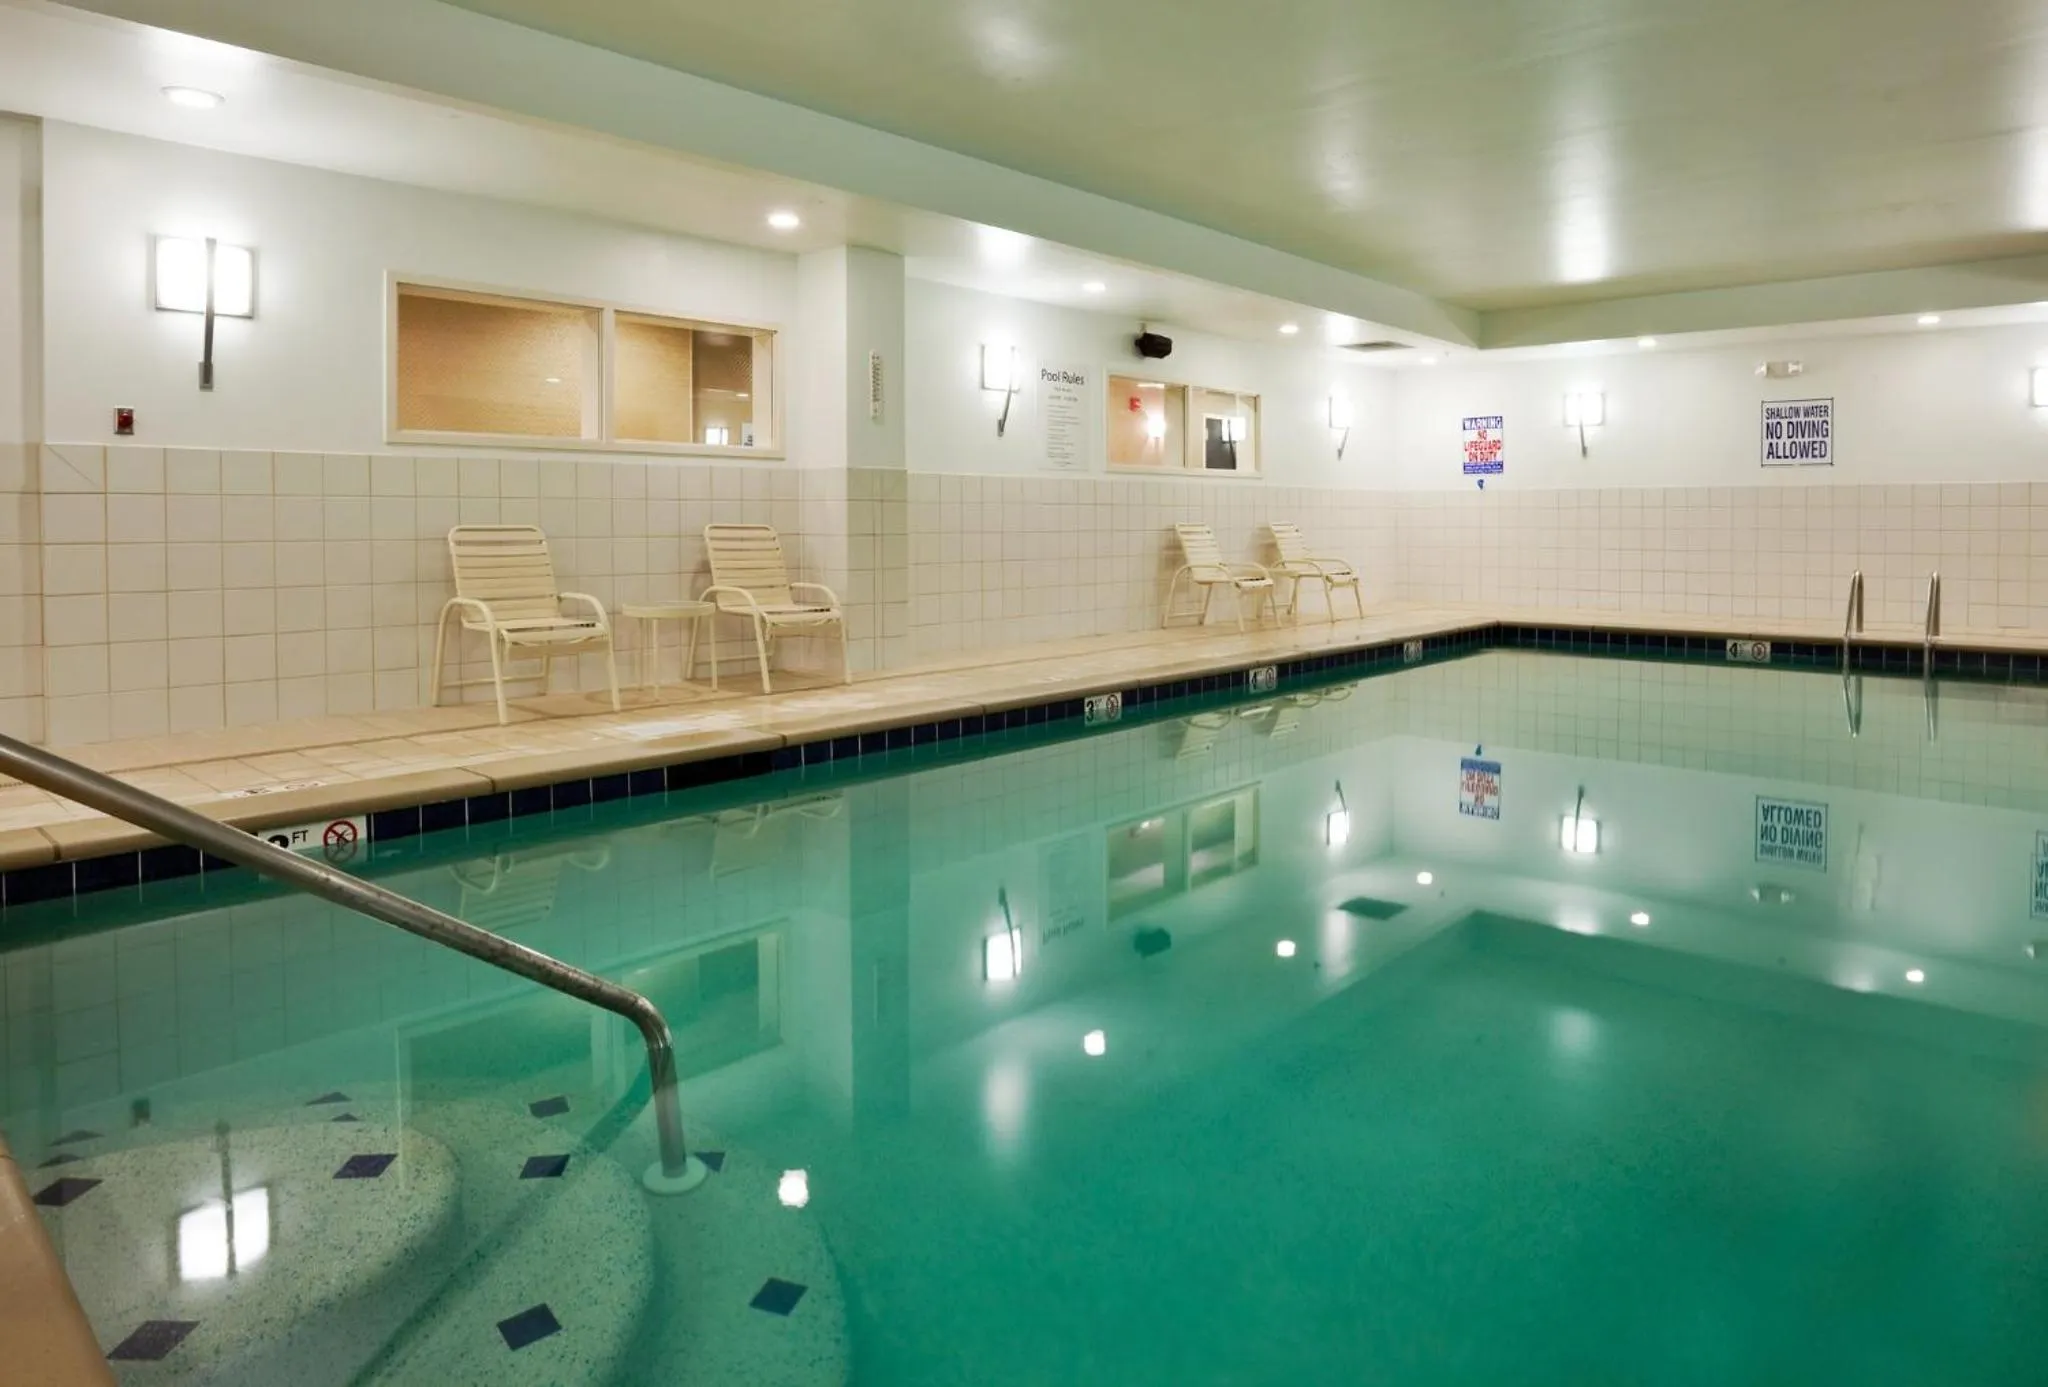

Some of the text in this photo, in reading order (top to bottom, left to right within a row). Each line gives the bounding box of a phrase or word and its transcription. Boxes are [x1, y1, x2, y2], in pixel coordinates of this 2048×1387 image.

[1041, 368, 1085, 385] Pool Rules
[1766, 405, 1829, 420] SHALLOW WATER
[1464, 417, 1502, 430] WARNING
[1766, 420, 1829, 440] NO DIVING
[1478, 430, 1487, 440] NO
[1465, 440, 1502, 452] LIFEGUARD
[1766, 440, 1827, 459] ALLOWED
[1469, 451, 1497, 462] ON DUTY
[292, 830, 308, 844] FT
